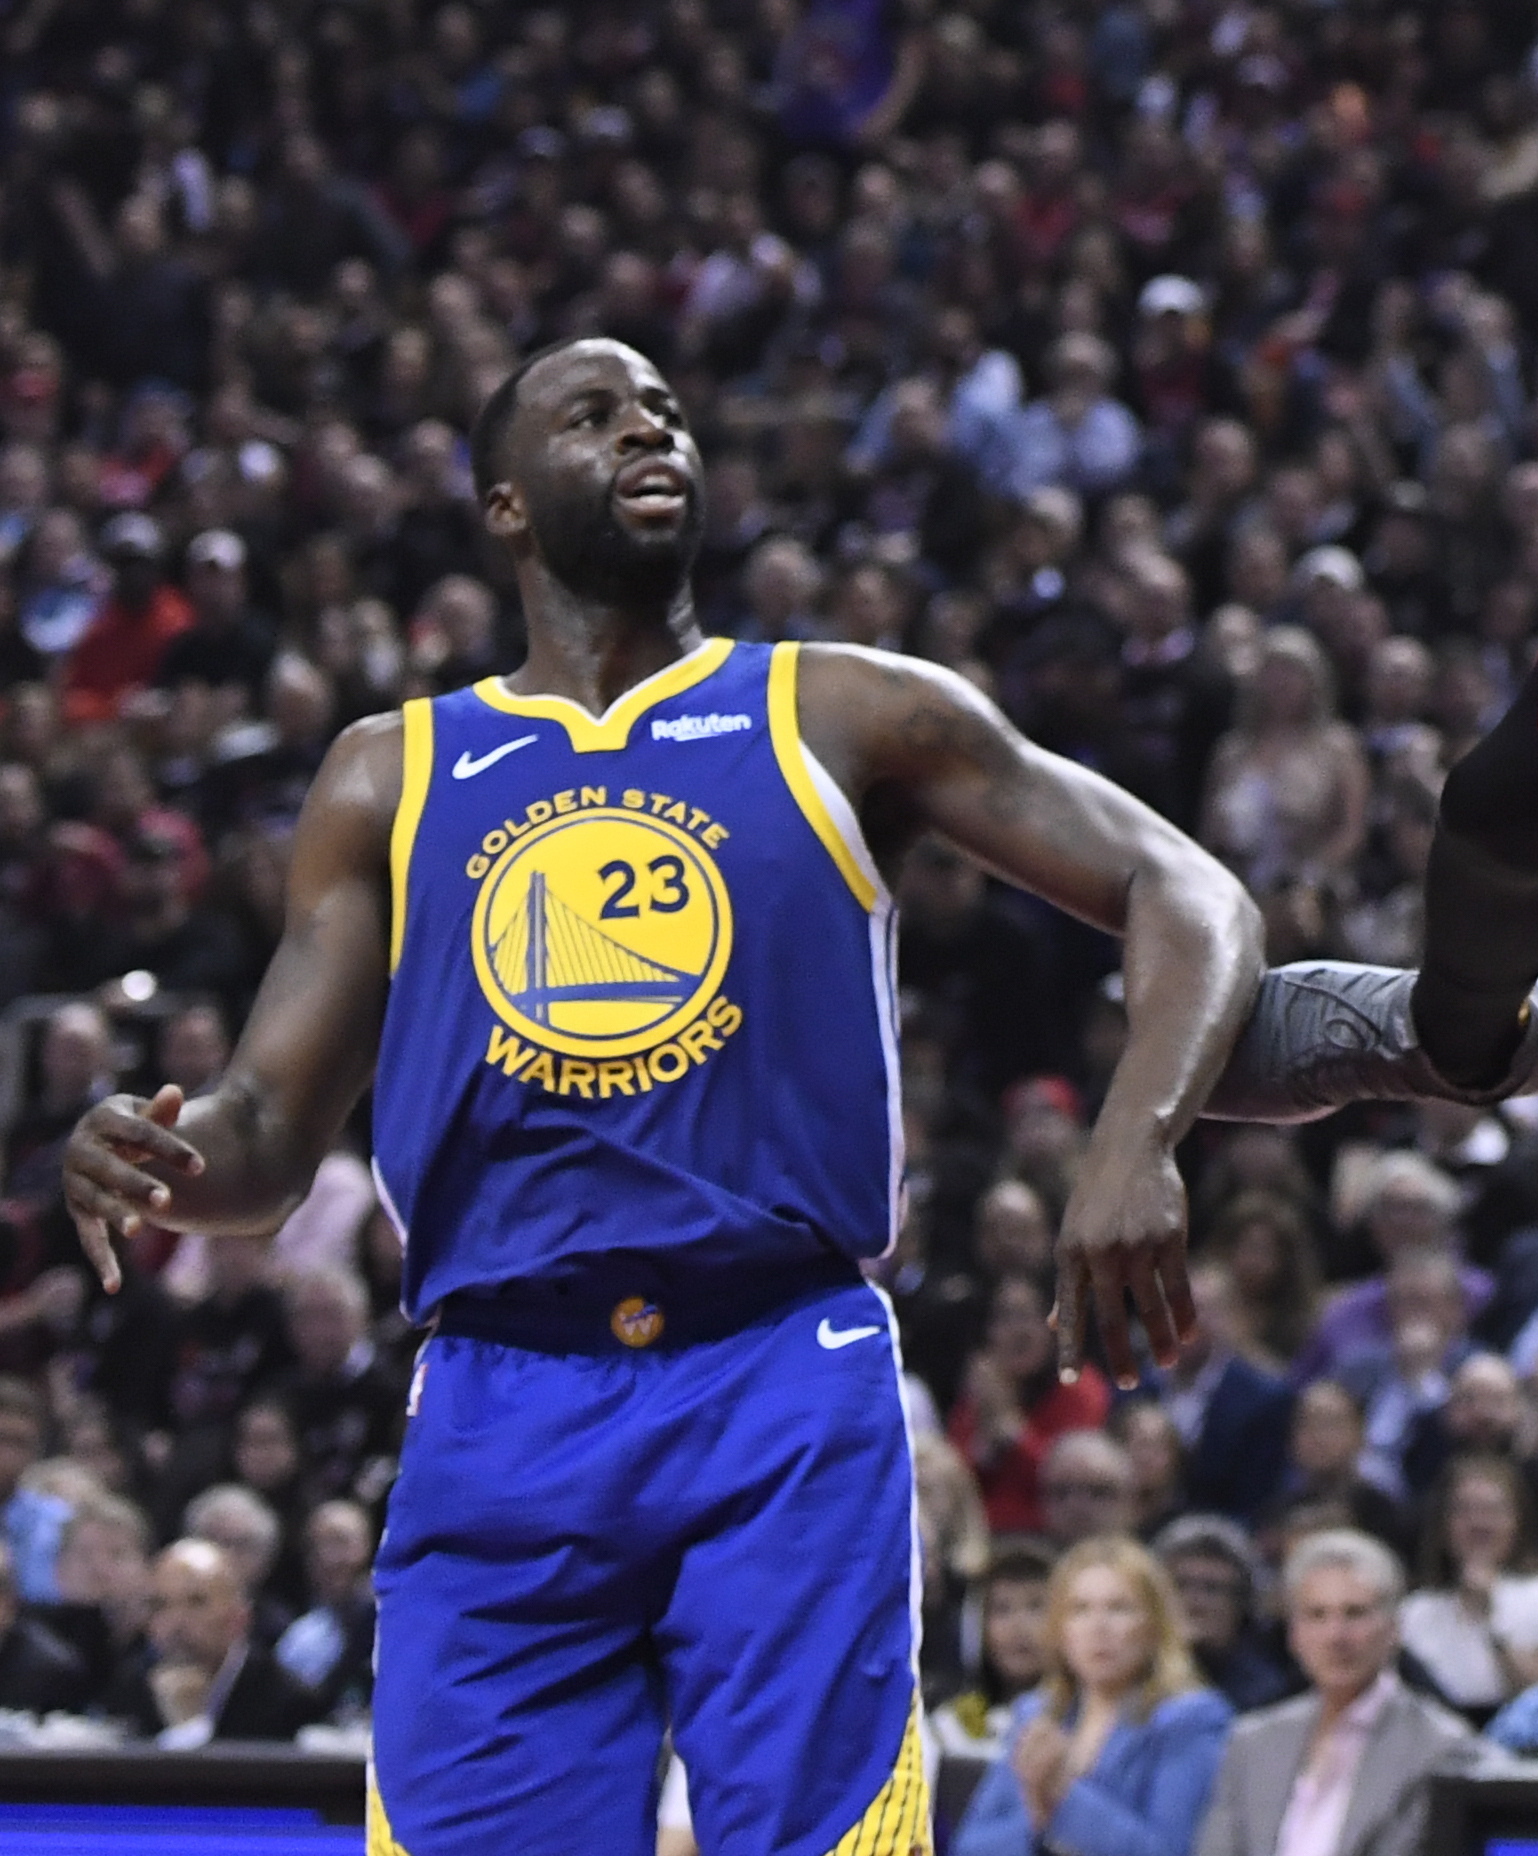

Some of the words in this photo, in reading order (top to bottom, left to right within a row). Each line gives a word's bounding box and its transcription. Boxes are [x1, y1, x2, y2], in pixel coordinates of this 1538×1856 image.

[651, 712, 752, 741] Rakuten
[465, 785, 607, 879] GOLDEN
[622, 788, 730, 849] STATE
[597, 854, 690, 920] 23
[484, 995, 744, 1099] WARRIORS
